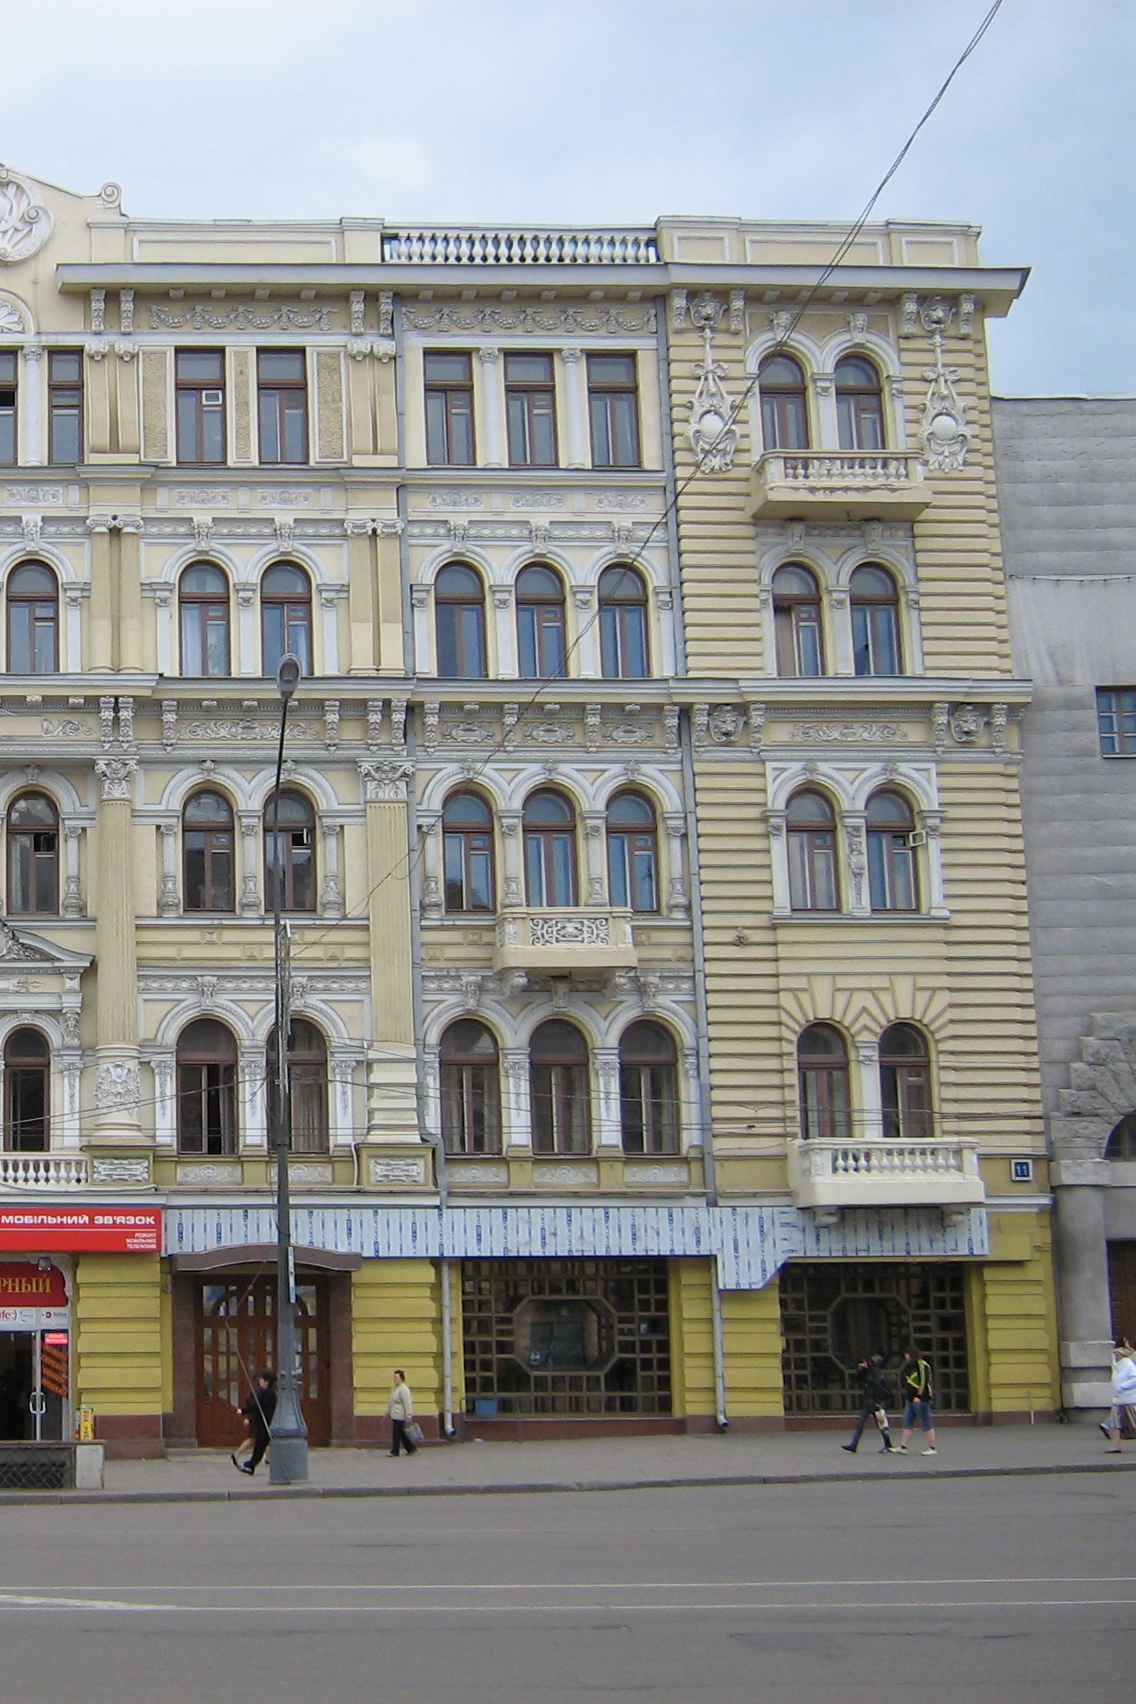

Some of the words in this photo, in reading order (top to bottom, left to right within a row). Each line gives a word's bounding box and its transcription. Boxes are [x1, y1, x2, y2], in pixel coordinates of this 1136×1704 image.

[1015, 1164, 1028, 1176] 11
[1, 1214, 90, 1225] МОБІЛЬНИЙ
[94, 1215, 156, 1225] ЗВ'ЯЗОК
